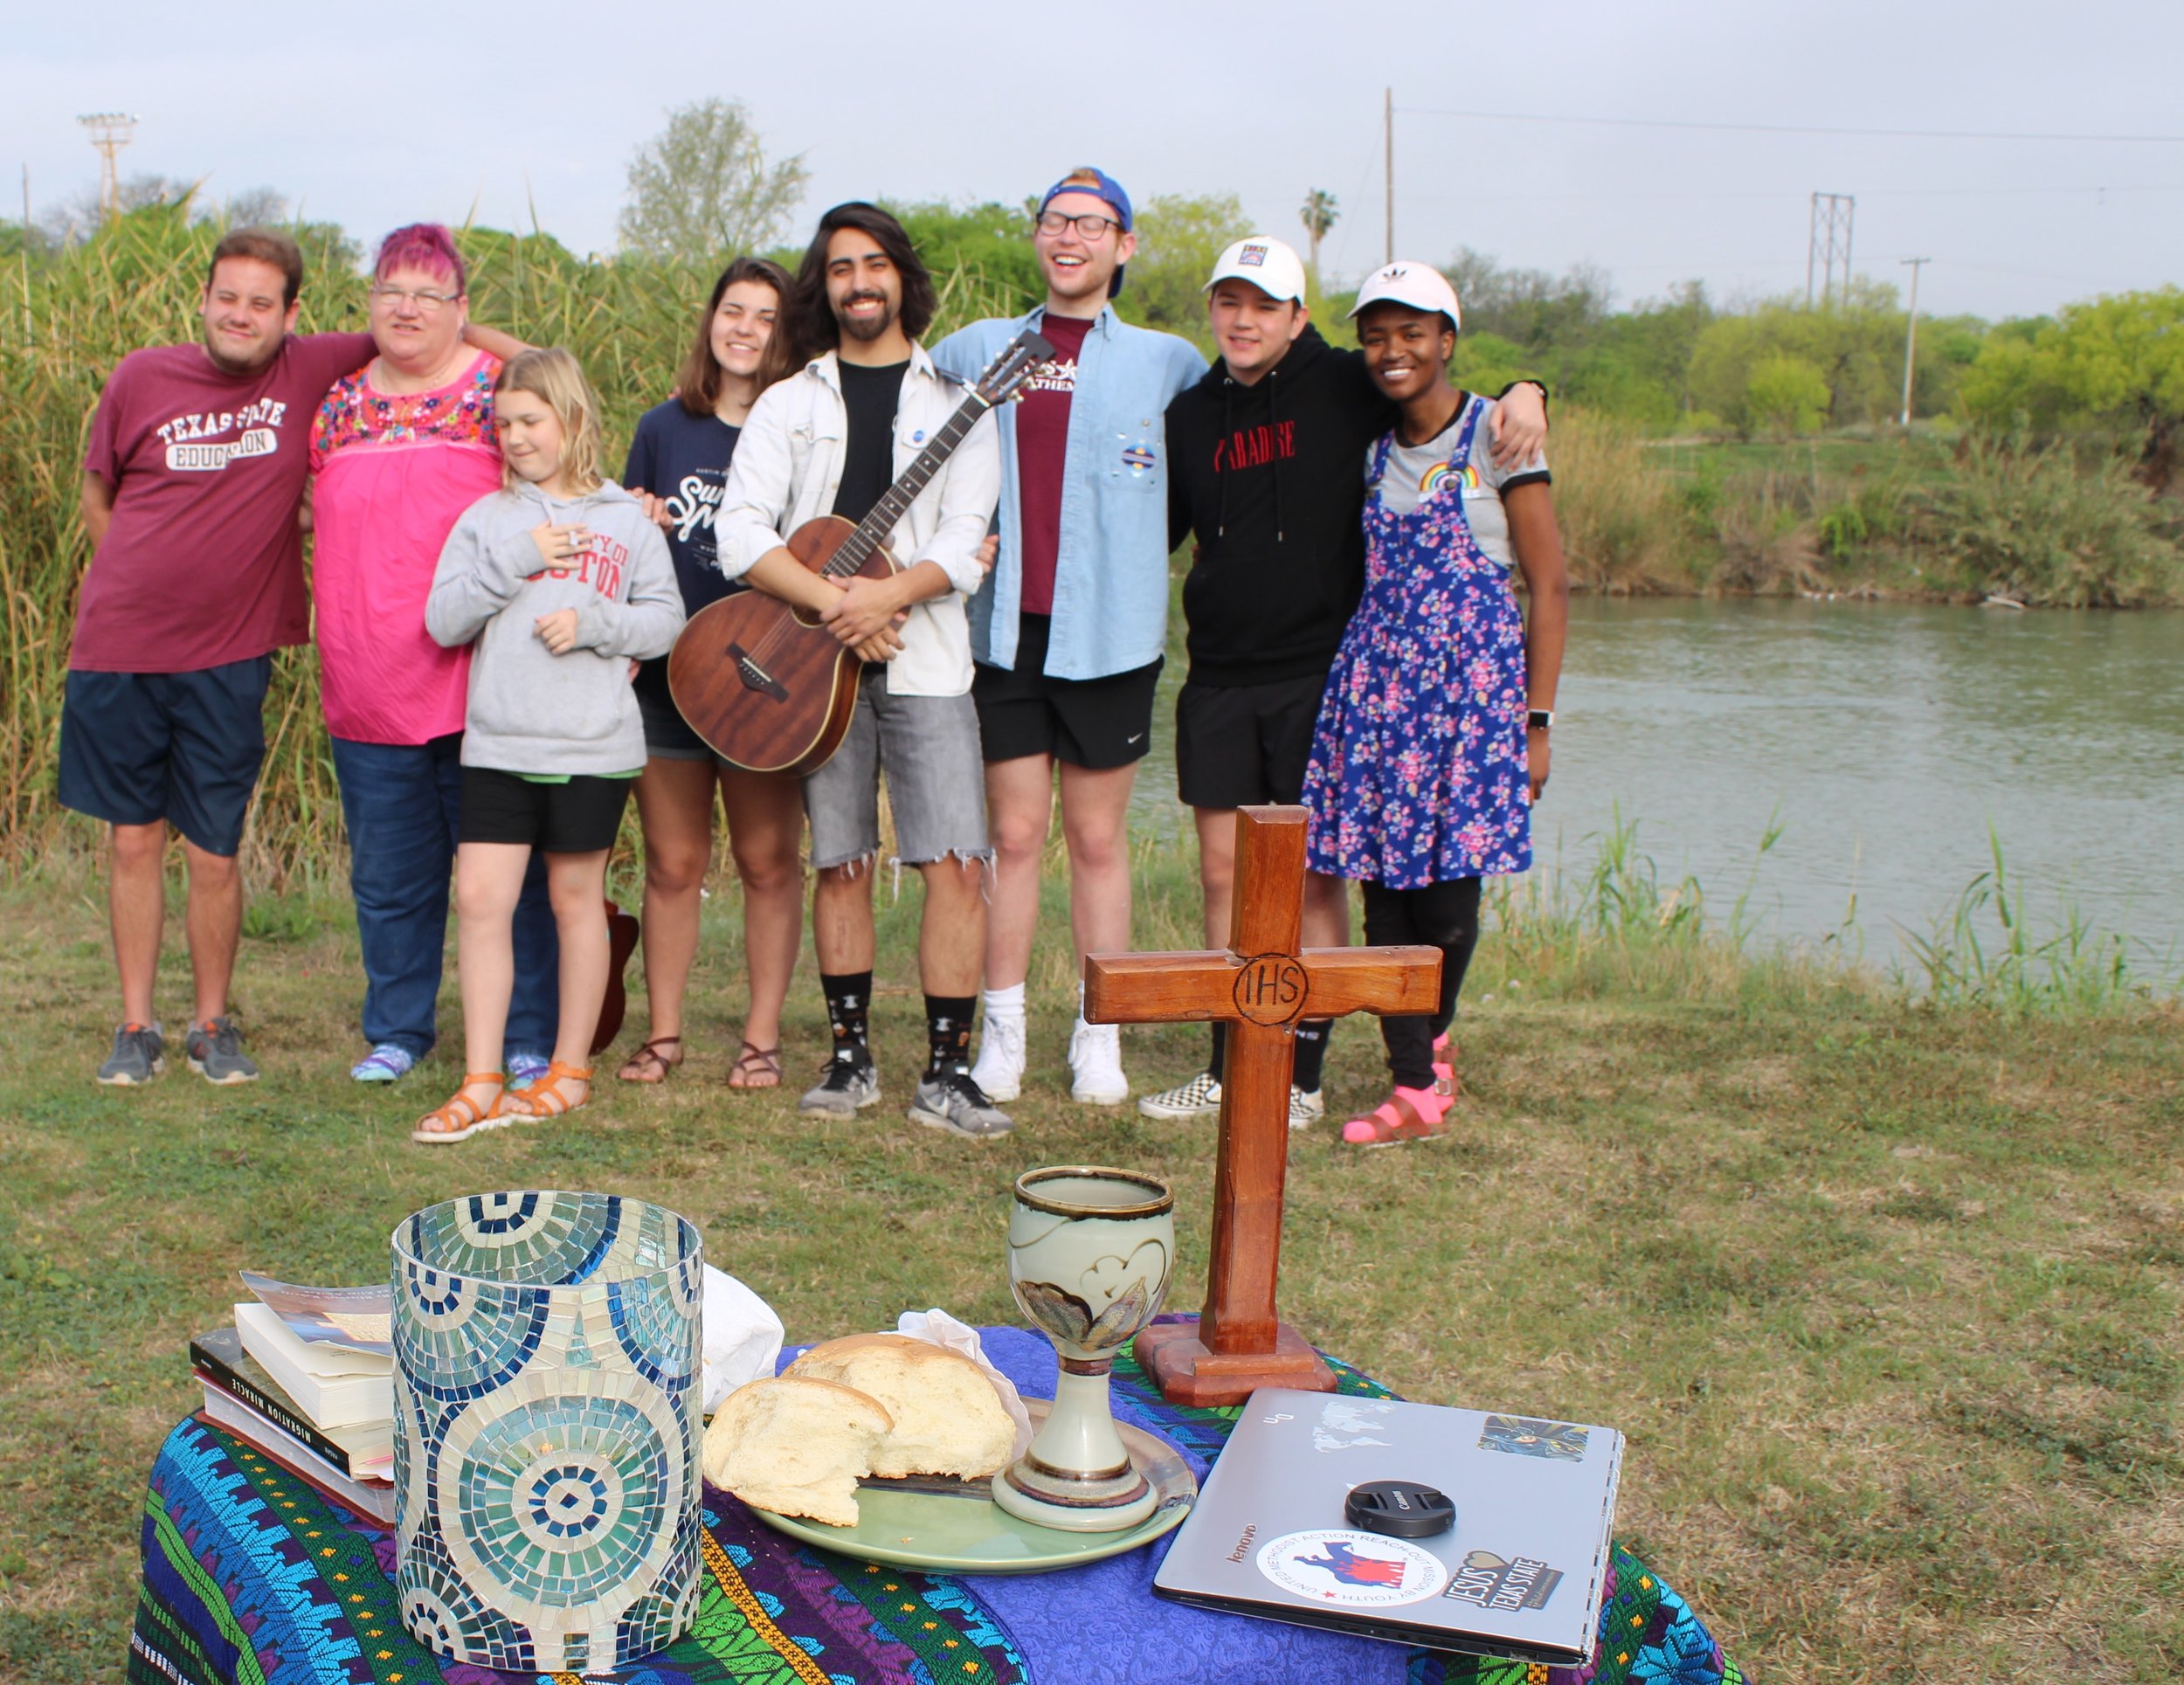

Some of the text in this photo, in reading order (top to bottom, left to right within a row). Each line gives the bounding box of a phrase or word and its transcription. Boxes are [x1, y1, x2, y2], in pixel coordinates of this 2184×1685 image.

[156, 397, 287, 445] TEXAS SATE
[176, 431, 267, 467] EDUCAION
[1246, 963, 1299, 1006] IHS
[232, 1378, 264, 1410] MIRACLE
[267, 1403, 312, 1444] MIGRATION
[1226, 1523, 1258, 1564] lenovo
[1267, 1532, 1434, 1601] UNITED METHODIST ACTION REACH-OUT MISSION BY YOUTH
[1504, 1557, 1545, 1585] STATE
[1446, 1567, 1498, 1607] JESUS
[1489, 1583, 1529, 1611] TEXAS
